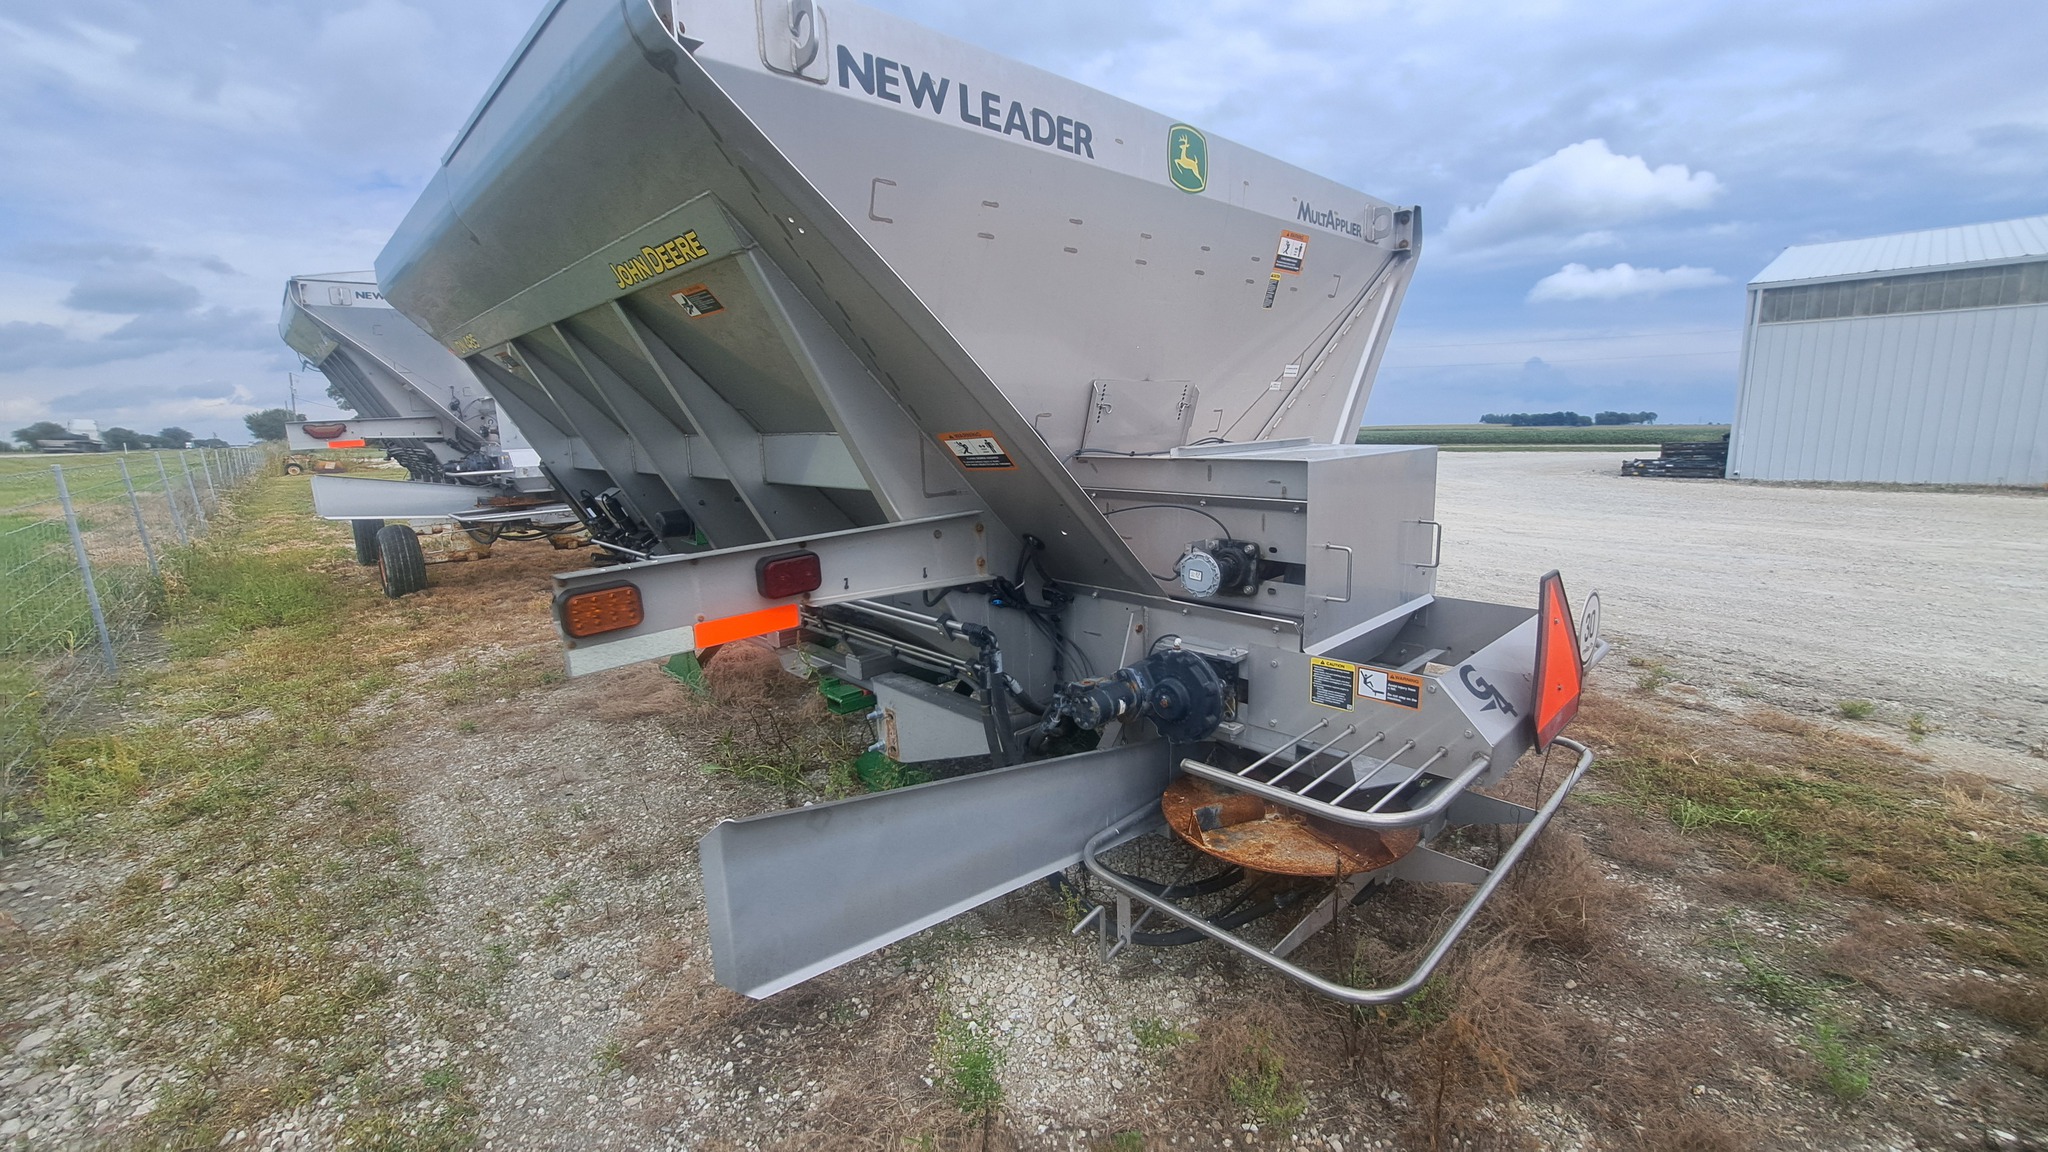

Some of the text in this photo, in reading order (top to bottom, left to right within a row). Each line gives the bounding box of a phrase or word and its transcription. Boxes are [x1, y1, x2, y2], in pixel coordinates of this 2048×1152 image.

[836, 44, 1095, 160] NEW LEADER
[609, 229, 708, 290] JOHN DEERE
[1584, 609, 1596, 643] 30
[1325, 661, 1345, 669] CAUTION
[1395, 676, 1419, 684] WARNING
